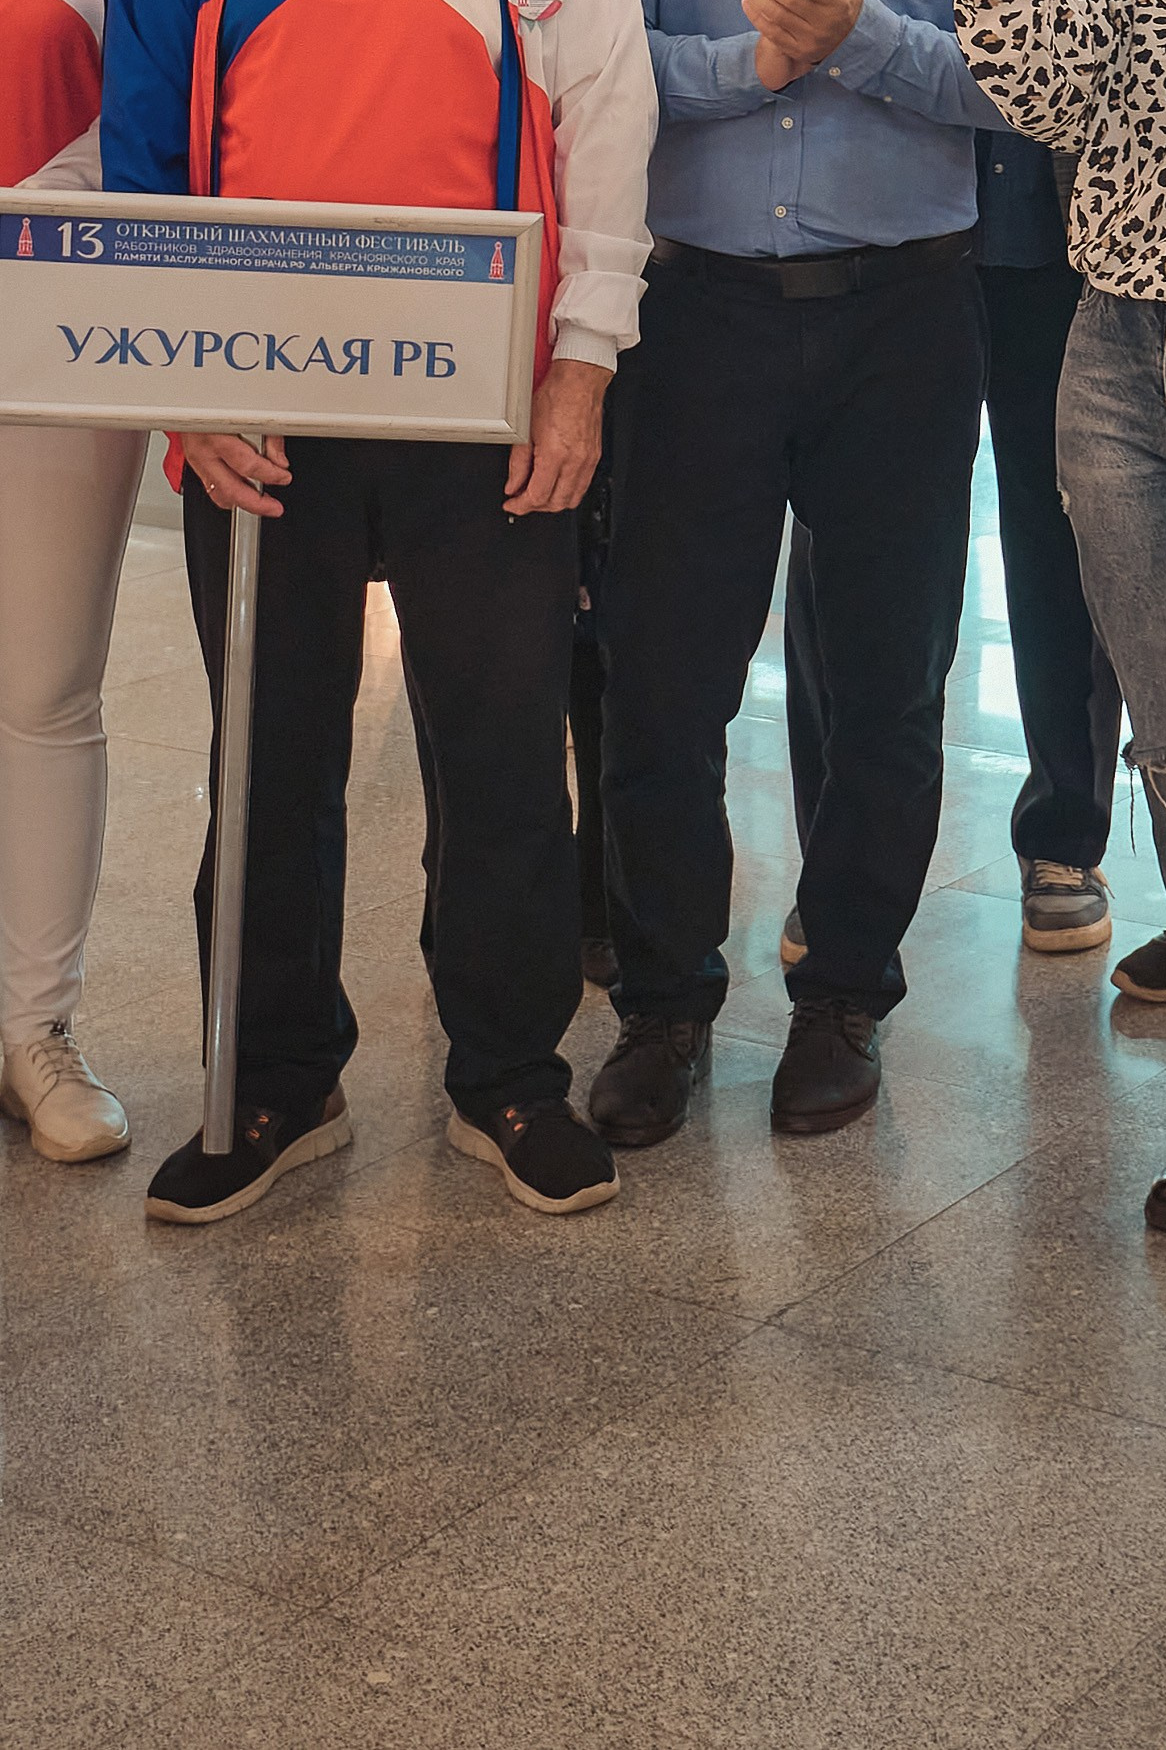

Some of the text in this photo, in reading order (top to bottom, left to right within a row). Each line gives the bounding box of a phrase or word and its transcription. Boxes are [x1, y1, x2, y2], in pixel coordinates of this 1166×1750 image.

[57, 221, 104, 259] 13
[116, 223, 465, 253] ОТКРЫТЫЙ ШАХМАТНЫЙ ФЕСТИВАЛЬ
[114, 240, 465, 267] РАБОТНИКОВ ЗДРАВООХРАНЕНИЯ КРАСНОЯРСКОГО КРАЯ
[114, 252, 465, 277] ПАМЯТИ ЗАСЛУЖЕННОГО ВРАЧА РФ АЛЬБЕРТА КРЫЖАНОВСКОГО
[57, 324, 457, 379] УЖУРСКАЯ РБ
